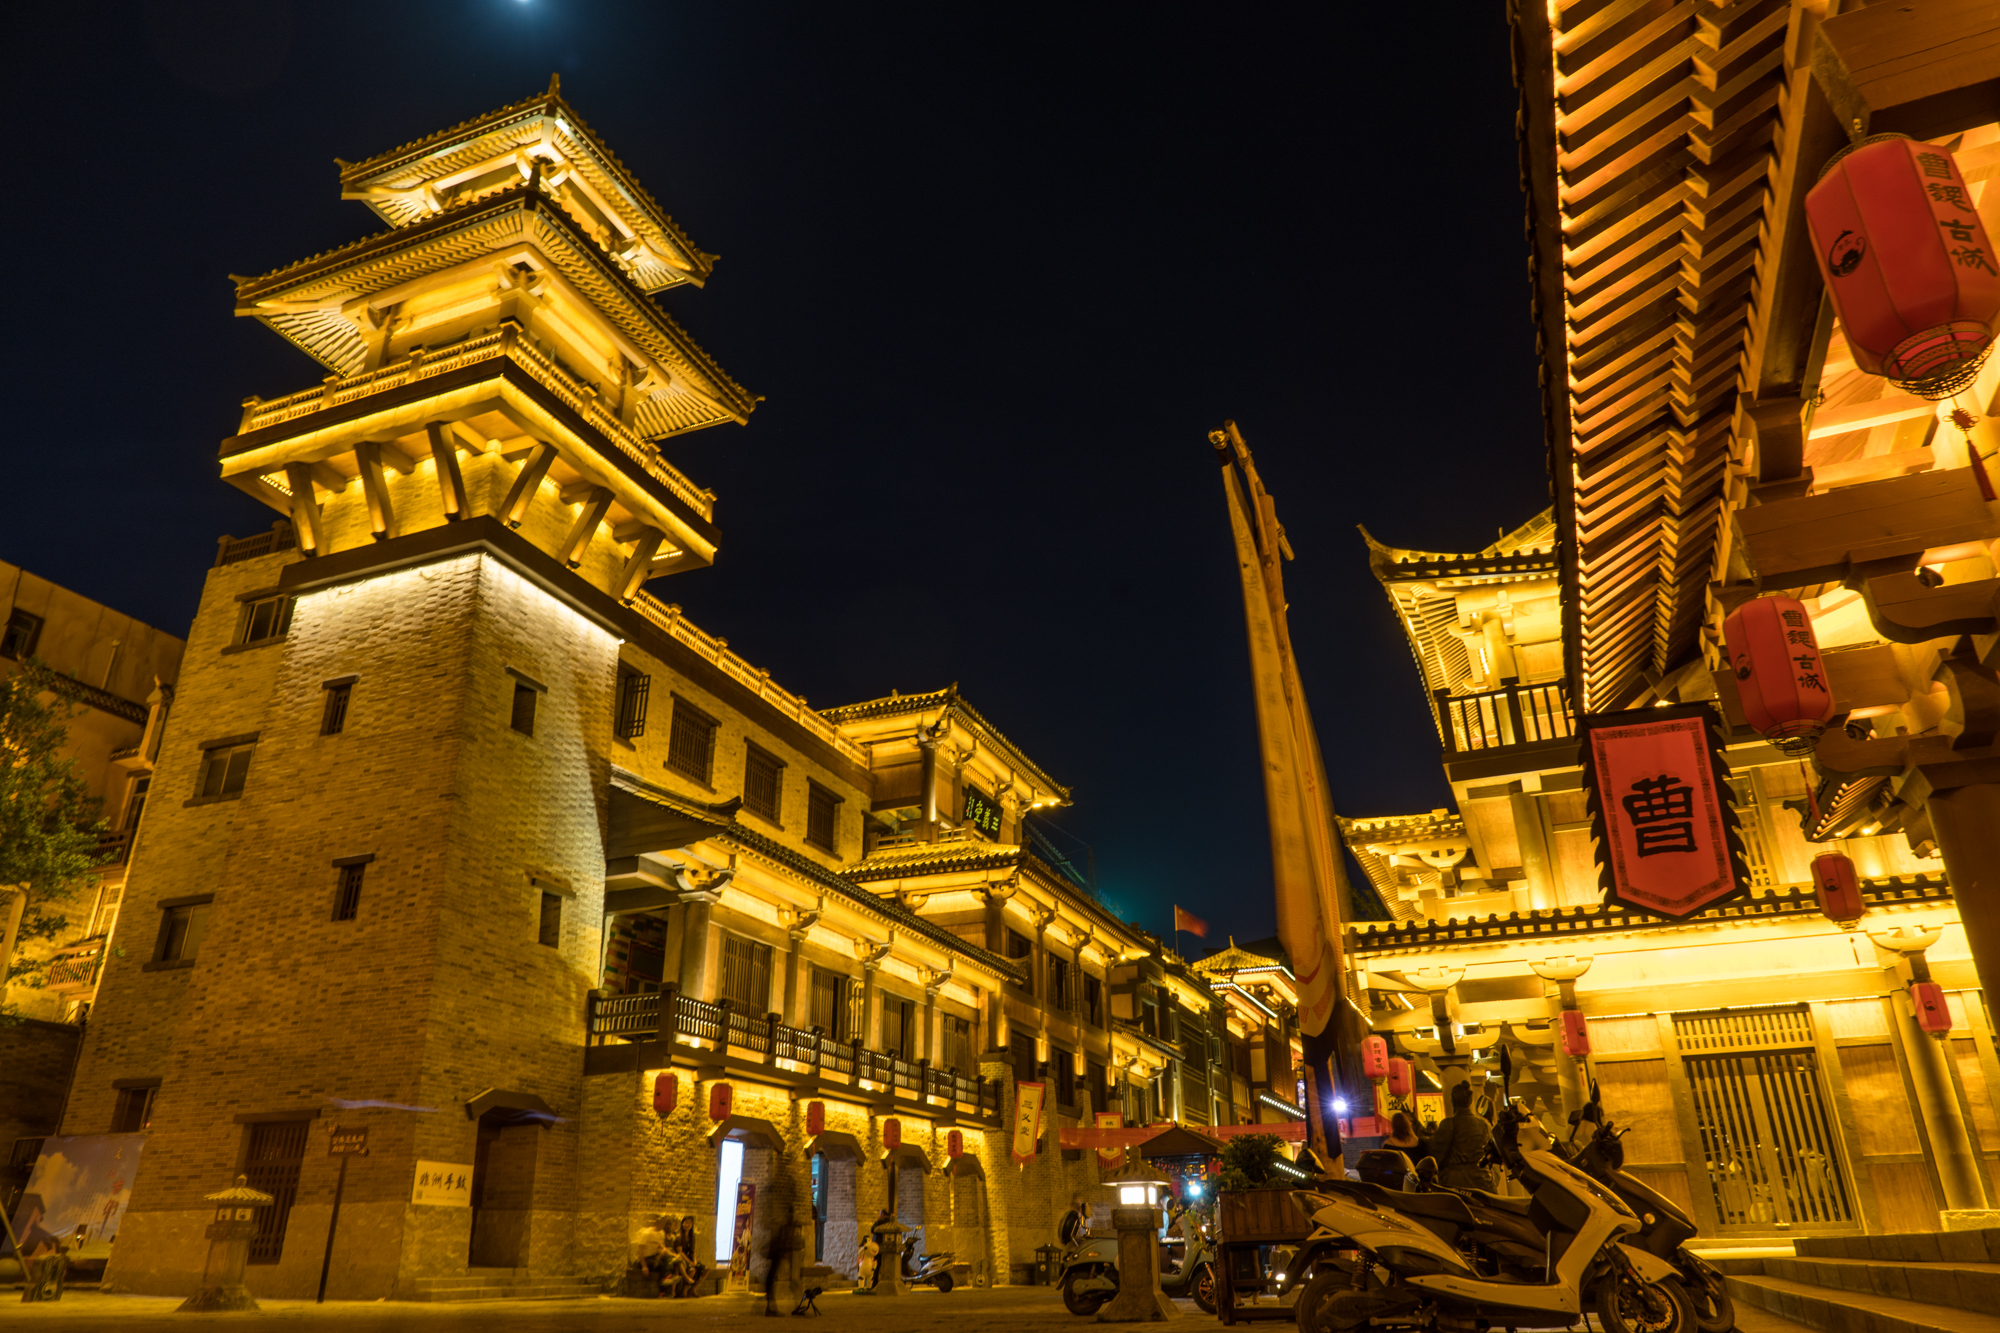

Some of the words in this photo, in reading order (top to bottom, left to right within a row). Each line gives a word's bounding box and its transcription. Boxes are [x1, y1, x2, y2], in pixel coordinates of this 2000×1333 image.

[1916, 151, 1998, 277] 曹魏古城
[1782, 609, 1826, 693] 曹魏古城
[1622, 774, 1698, 859] 曹
